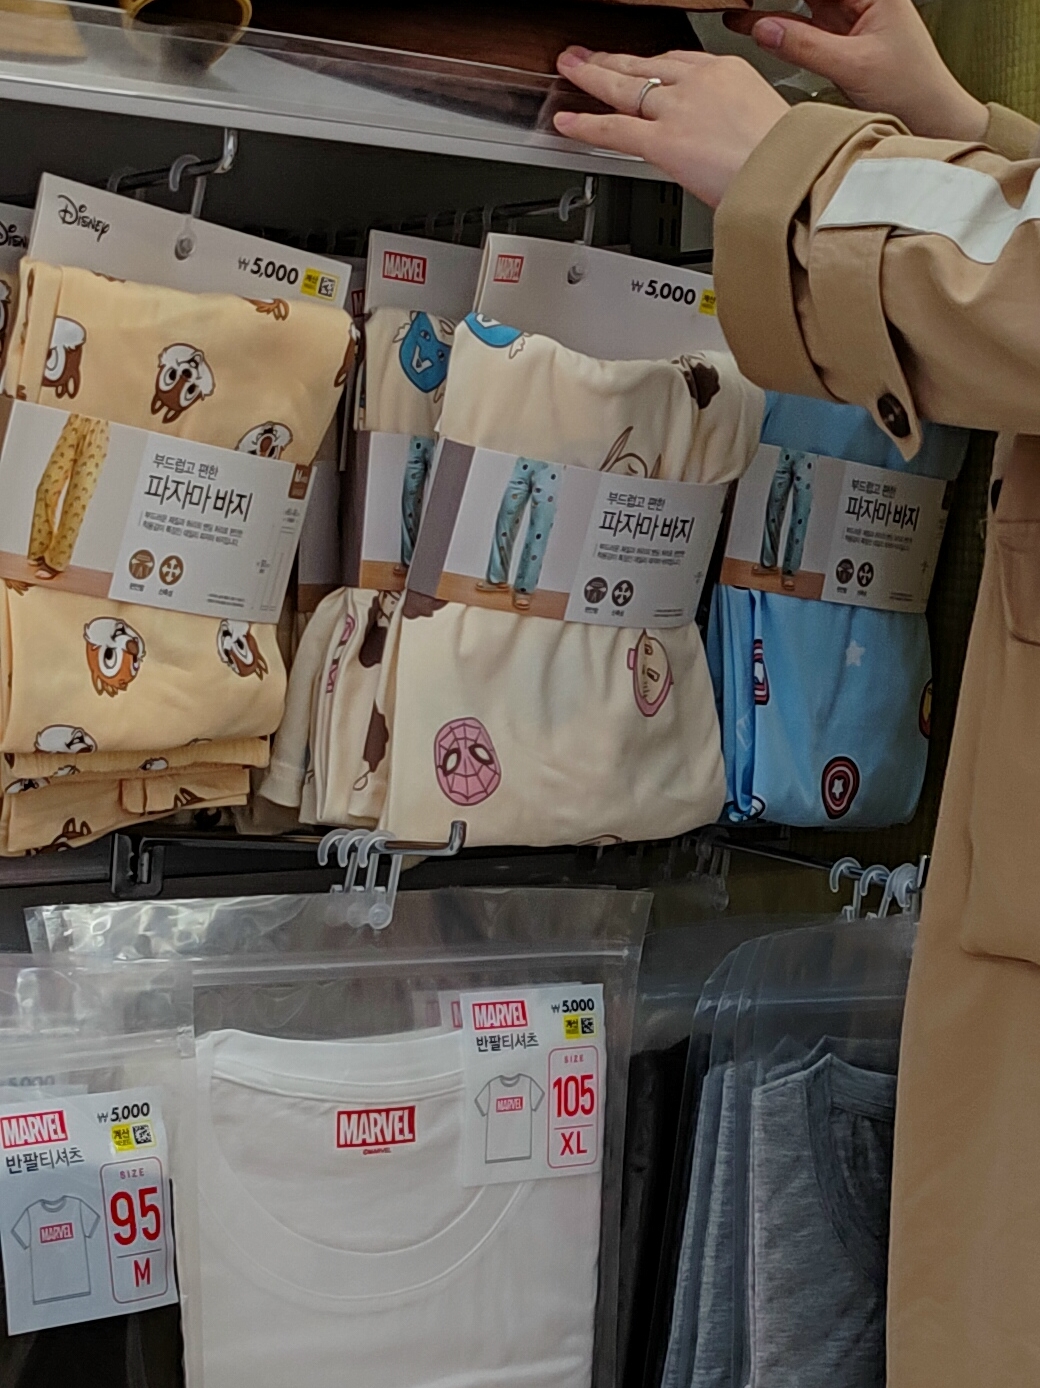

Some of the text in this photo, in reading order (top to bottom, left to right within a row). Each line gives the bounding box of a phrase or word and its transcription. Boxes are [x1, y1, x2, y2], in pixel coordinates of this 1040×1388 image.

[384, 253, 425, 283] MARVEL
[495, 255, 524, 282] MARVEL
[153, 453, 219, 480] 부드럽고 편한
[144, 474, 211, 514] 파자마
[212, 488, 253, 522] 바지
[607, 491, 646, 508] 부드럽고
[599, 510, 695, 543] 파자마 바지
[845, 495, 920, 531] 파자마 바지
[474, 1002, 527, 1029] MARVEL
[476, 1032, 539, 1052] 반팔티셔츠
[564, 1054, 584, 1063] SIZE
[497, 1098, 523, 1112] MARVEL
[553, 1074, 595, 1118] 105
[2, 1111, 66, 1147] MARVEL
[339, 1108, 414, 1145] MARVEL
[560, 1130, 587, 1156] XL
[6, 1147, 85, 1175] 반팔티셔츠
[120, 1168, 145, 1180] SIZE
[110, 1186, 161, 1246] 95
[41, 1223, 73, 1242] MARVEL
[134, 1257, 150, 1287] M
